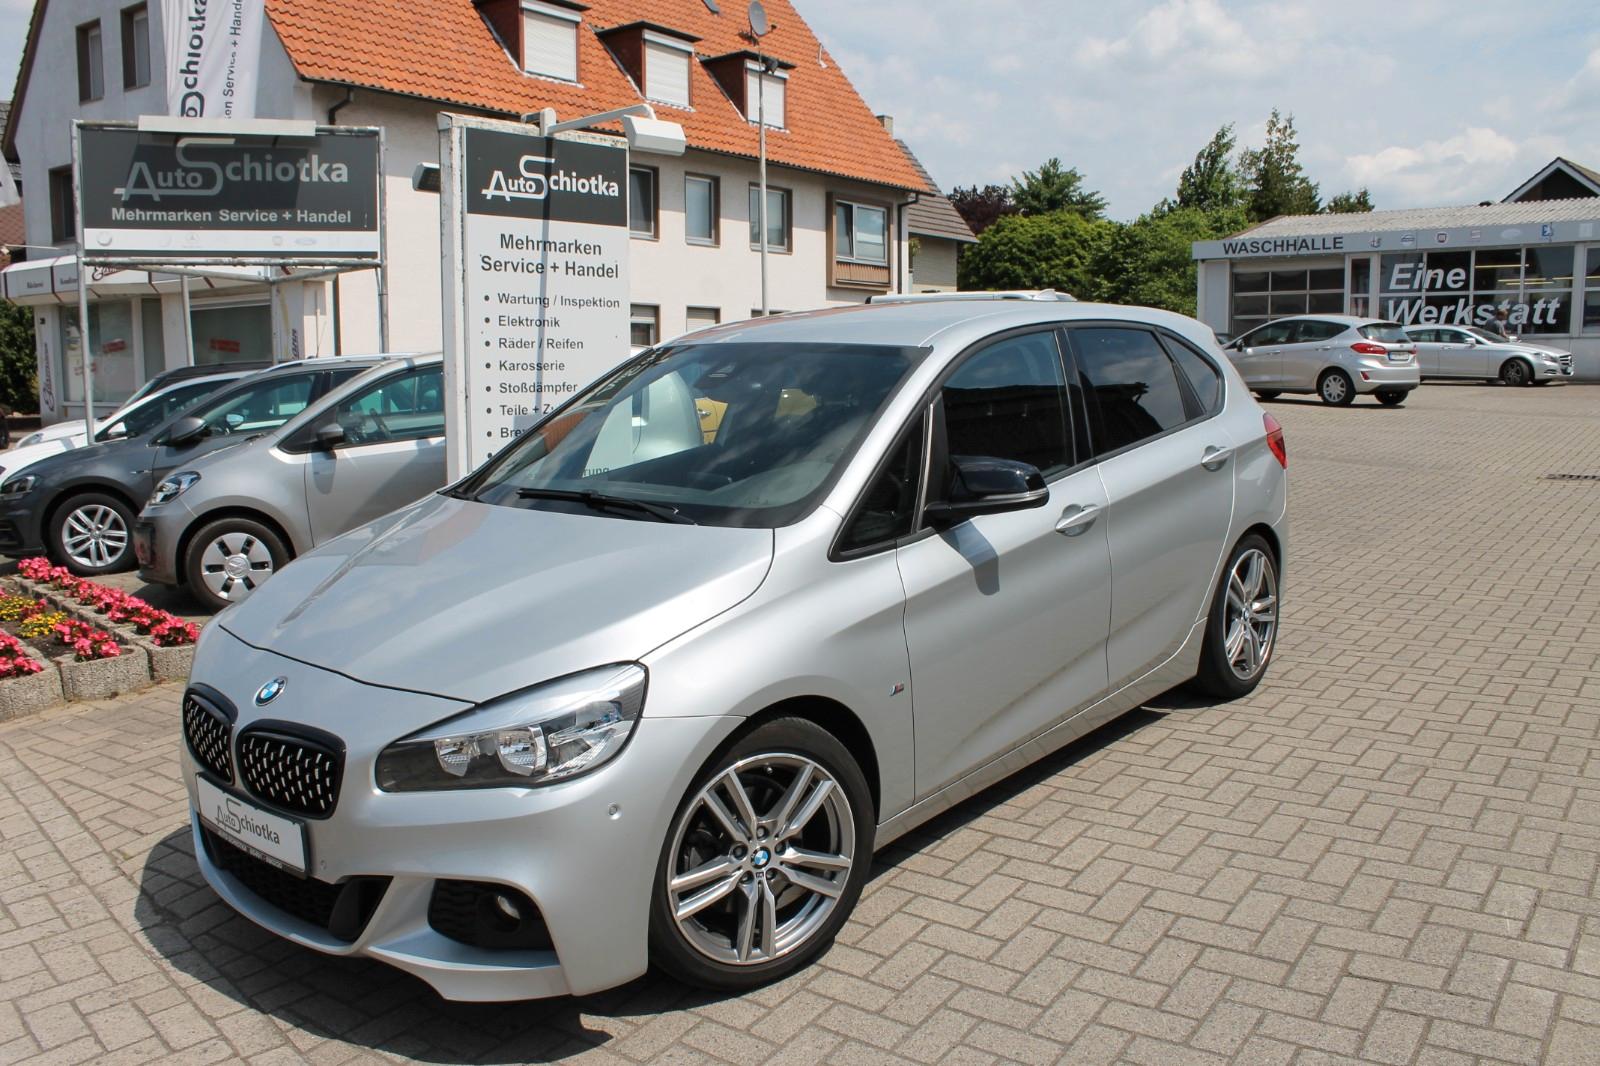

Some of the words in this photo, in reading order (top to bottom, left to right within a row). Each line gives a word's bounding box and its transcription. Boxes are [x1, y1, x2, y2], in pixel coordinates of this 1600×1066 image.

[113, 161, 204, 202] Auto
[175, 137, 348, 196] Schiotka
[481, 170, 537, 202] Auto
[518, 154, 620, 200] Schiotka
[111, 207, 212, 222] Mehrmarken
[219, 209, 278, 223] Service
[296, 210, 352, 223] Handel
[499, 233, 602, 256] Mehrmarken
[1223, 236, 1344, 255] WASCHHALLE
[480, 254, 545, 275] Service
[564, 261, 619, 279] Handel
[1389, 262, 1466, 290] Eine
[497, 293, 550, 308] Wartung
[560, 295, 621, 309] Inspektion
[498, 315, 561, 328] Elektronik
[498, 337, 536, 349] Räder
[546, 338, 584, 349] Reifen
[499, 360, 566, 372] Karosserie
[499, 382, 578, 396] Stoßdämpfer
[500, 404, 529, 416] Teile
